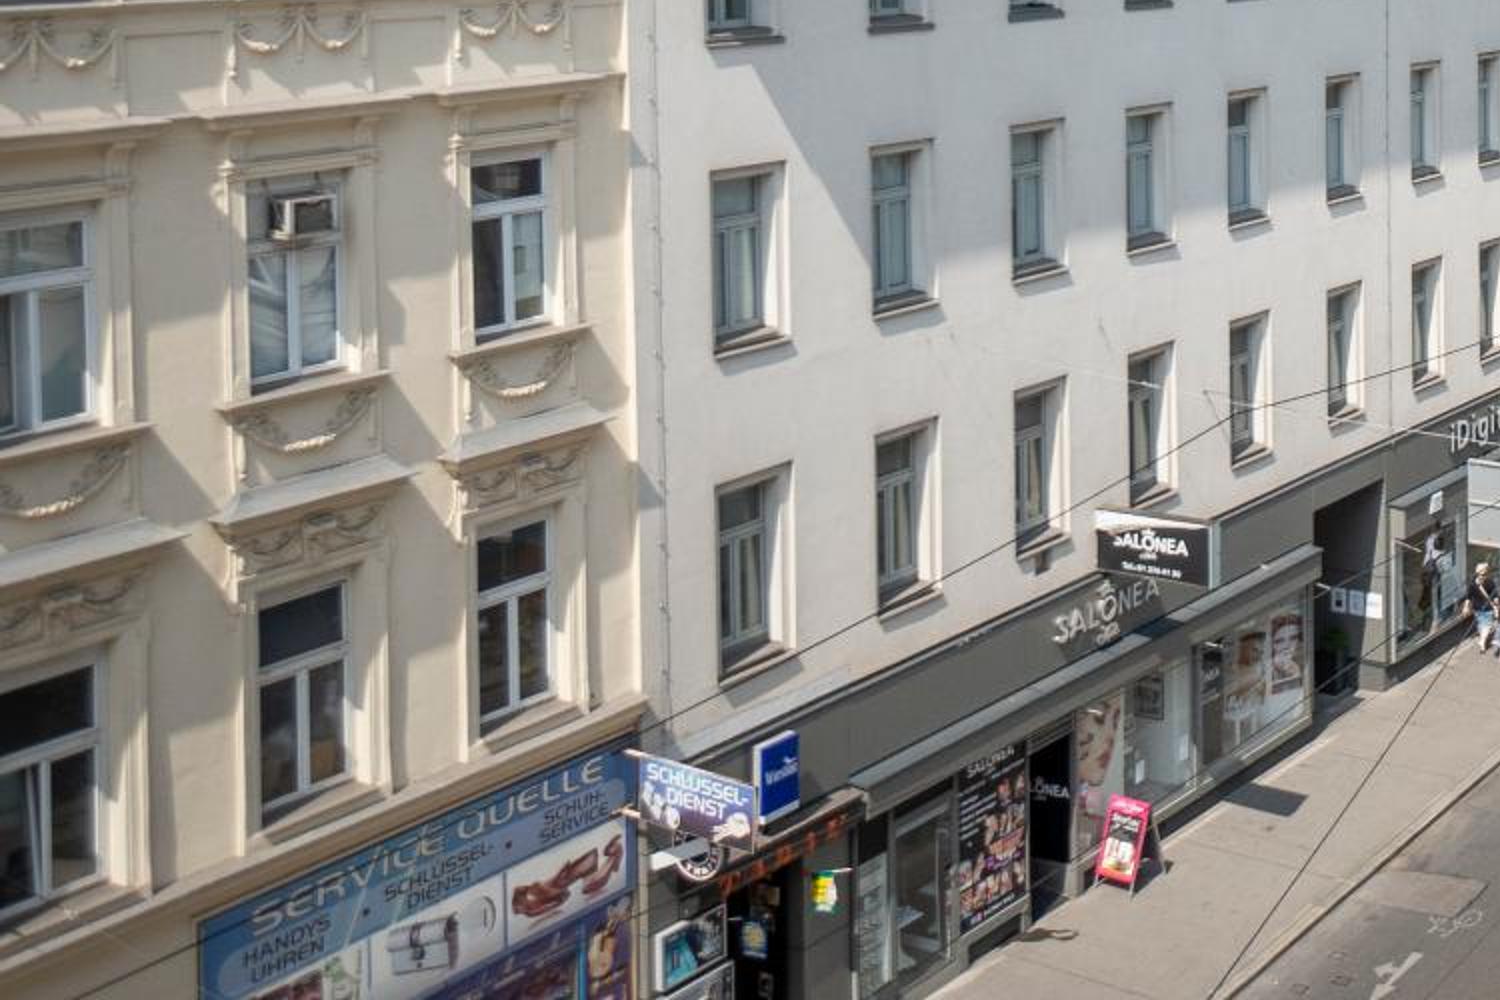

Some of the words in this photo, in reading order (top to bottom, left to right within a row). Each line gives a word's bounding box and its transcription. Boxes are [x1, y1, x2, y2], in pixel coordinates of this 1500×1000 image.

[1052, 577, 1159, 644] SALONEA
[540, 801, 610, 846] SERVICE
[543, 790, 604, 823] SCHUH-
[666, 787, 728, 819] DIENST
[252, 821, 443, 937] SERVICE
[456, 755, 607, 840] QUELLE
[406, 867, 473, 910] DIENST
[242, 915, 332, 968] HANDYS
[251, 937, 327, 983] UHREN
